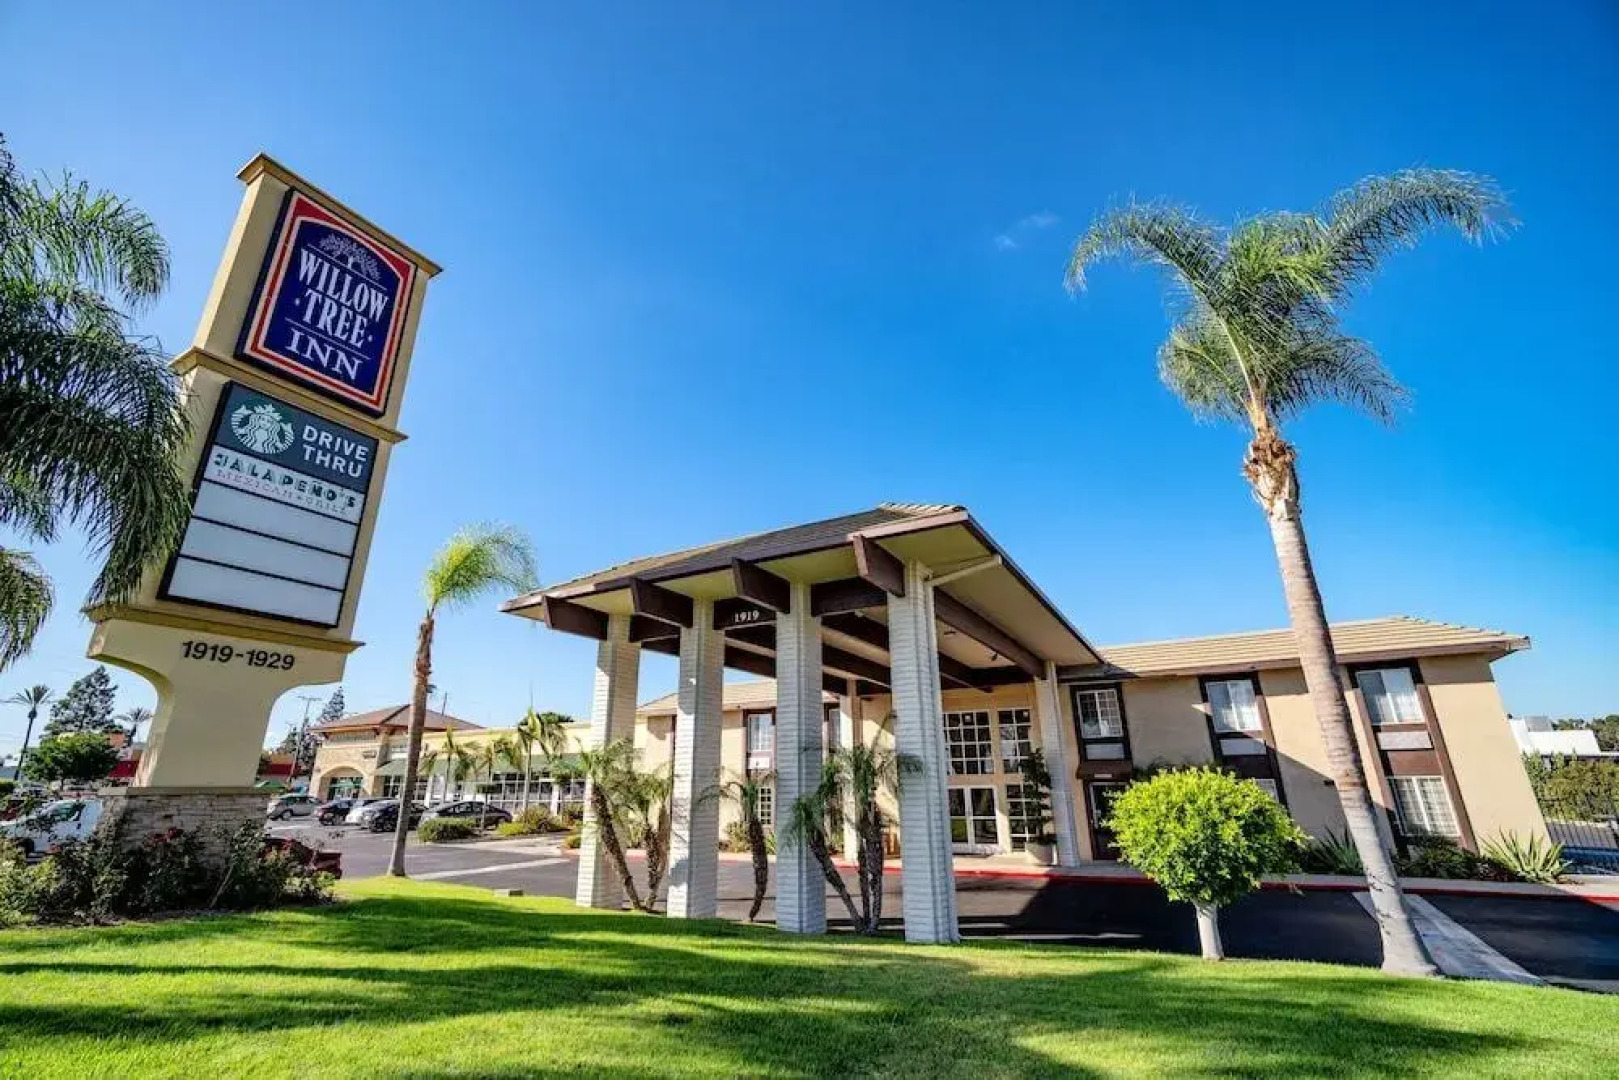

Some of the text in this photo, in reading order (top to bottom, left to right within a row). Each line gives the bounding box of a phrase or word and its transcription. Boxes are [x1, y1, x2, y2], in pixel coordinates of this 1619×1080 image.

[300, 248, 389, 322] WILLOW
[303, 288, 367, 348] TREE
[285, 327, 363, 380] INN
[303, 425, 369, 461] DRIVE
[303, 444, 362, 477] THRU
[734, 610, 760, 622] 1919
[182, 641, 295, 670] 1919-1929
